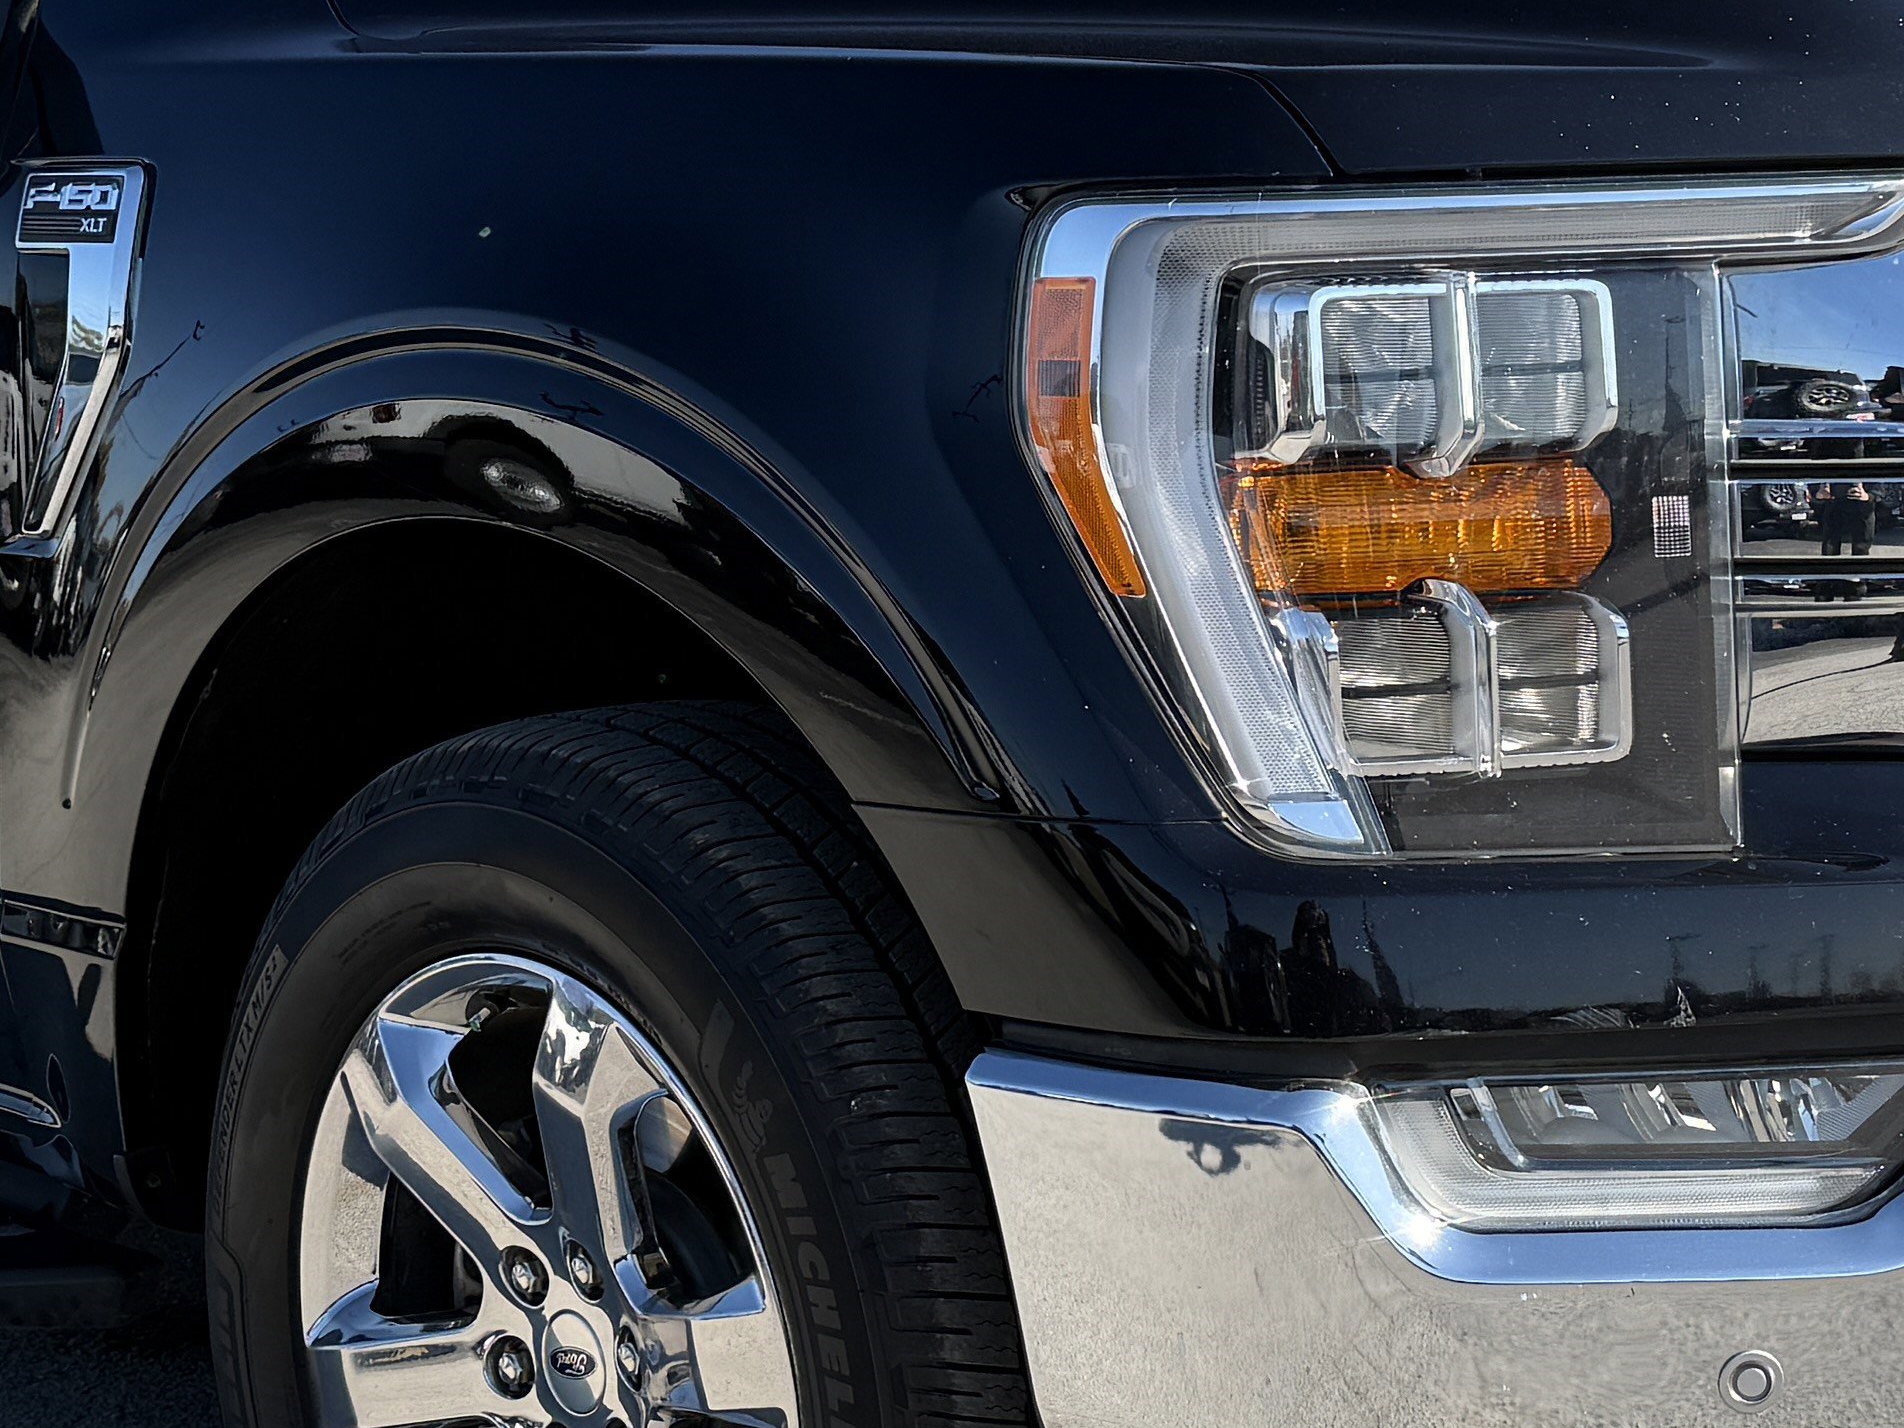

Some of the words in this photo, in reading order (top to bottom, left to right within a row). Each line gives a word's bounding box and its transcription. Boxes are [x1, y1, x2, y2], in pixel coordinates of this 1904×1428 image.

[24, 182, 119, 210] F-150
[79, 217, 107, 233] XLT
[556, 1352, 587, 1375] Ford
